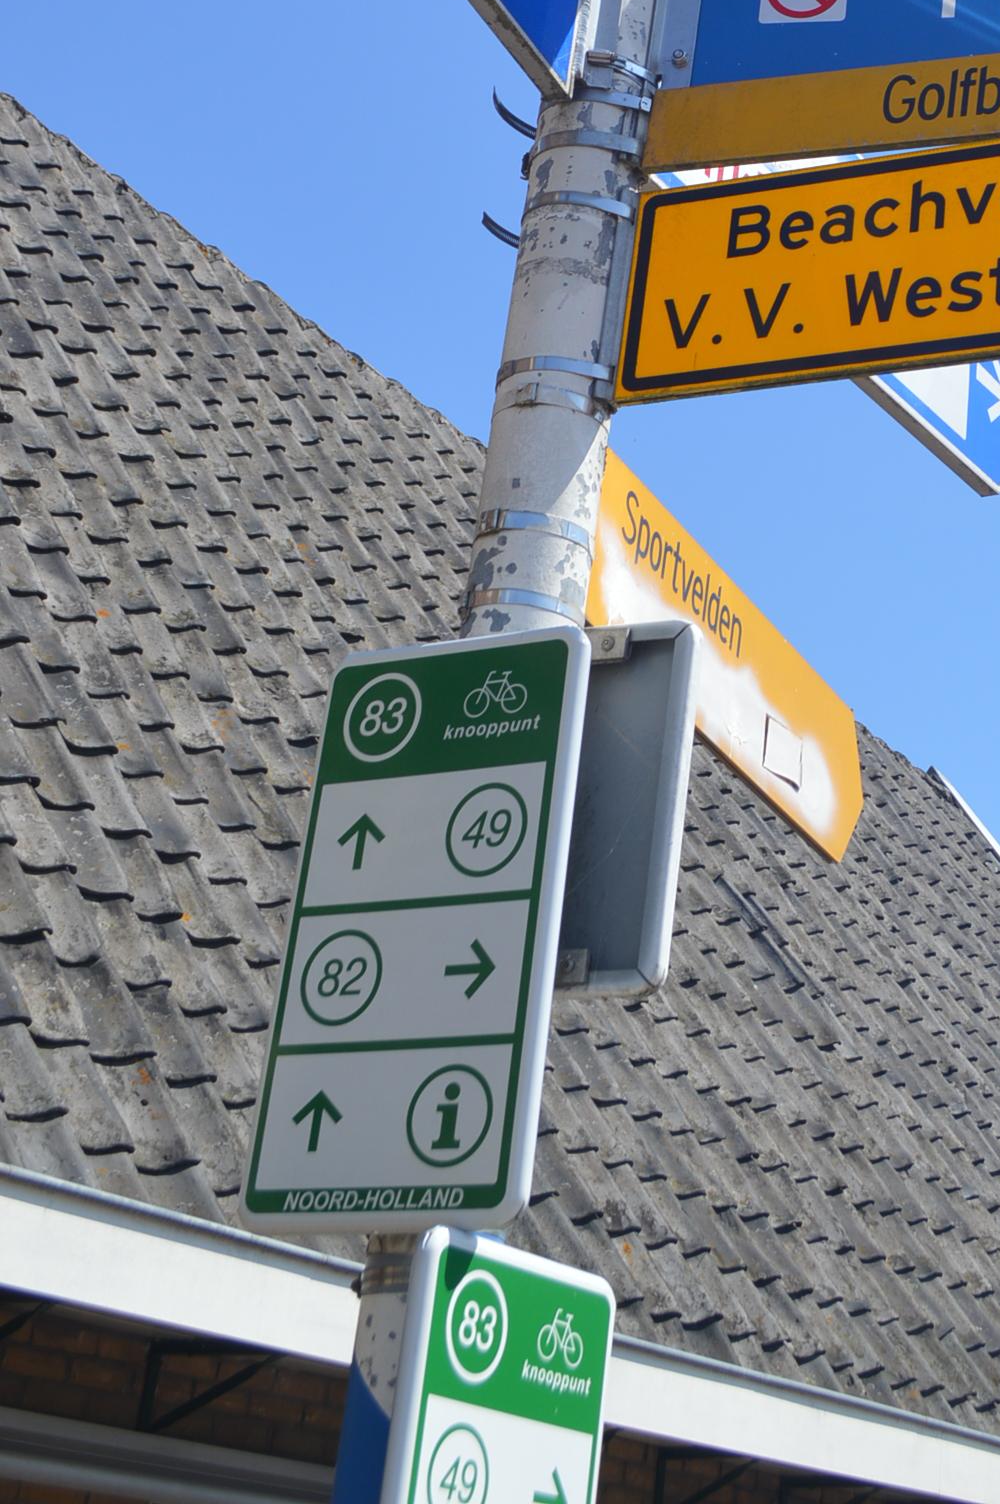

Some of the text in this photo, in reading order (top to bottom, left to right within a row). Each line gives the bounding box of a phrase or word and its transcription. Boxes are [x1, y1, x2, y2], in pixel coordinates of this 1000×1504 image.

[621, 490, 743, 658] Sportvelden
[359, 695, 409, 738] 83
[443, 713, 541, 742] knooppunt
[460, 807, 512, 850] 49
[316, 956, 369, 997] 82
[283, 1186, 465, 1212] NOORD-HOLLAND
[458, 1300, 498, 1352] 83
[521, 1358, 592, 1395] knooppunt
[440, 1455, 478, 1504] 49
